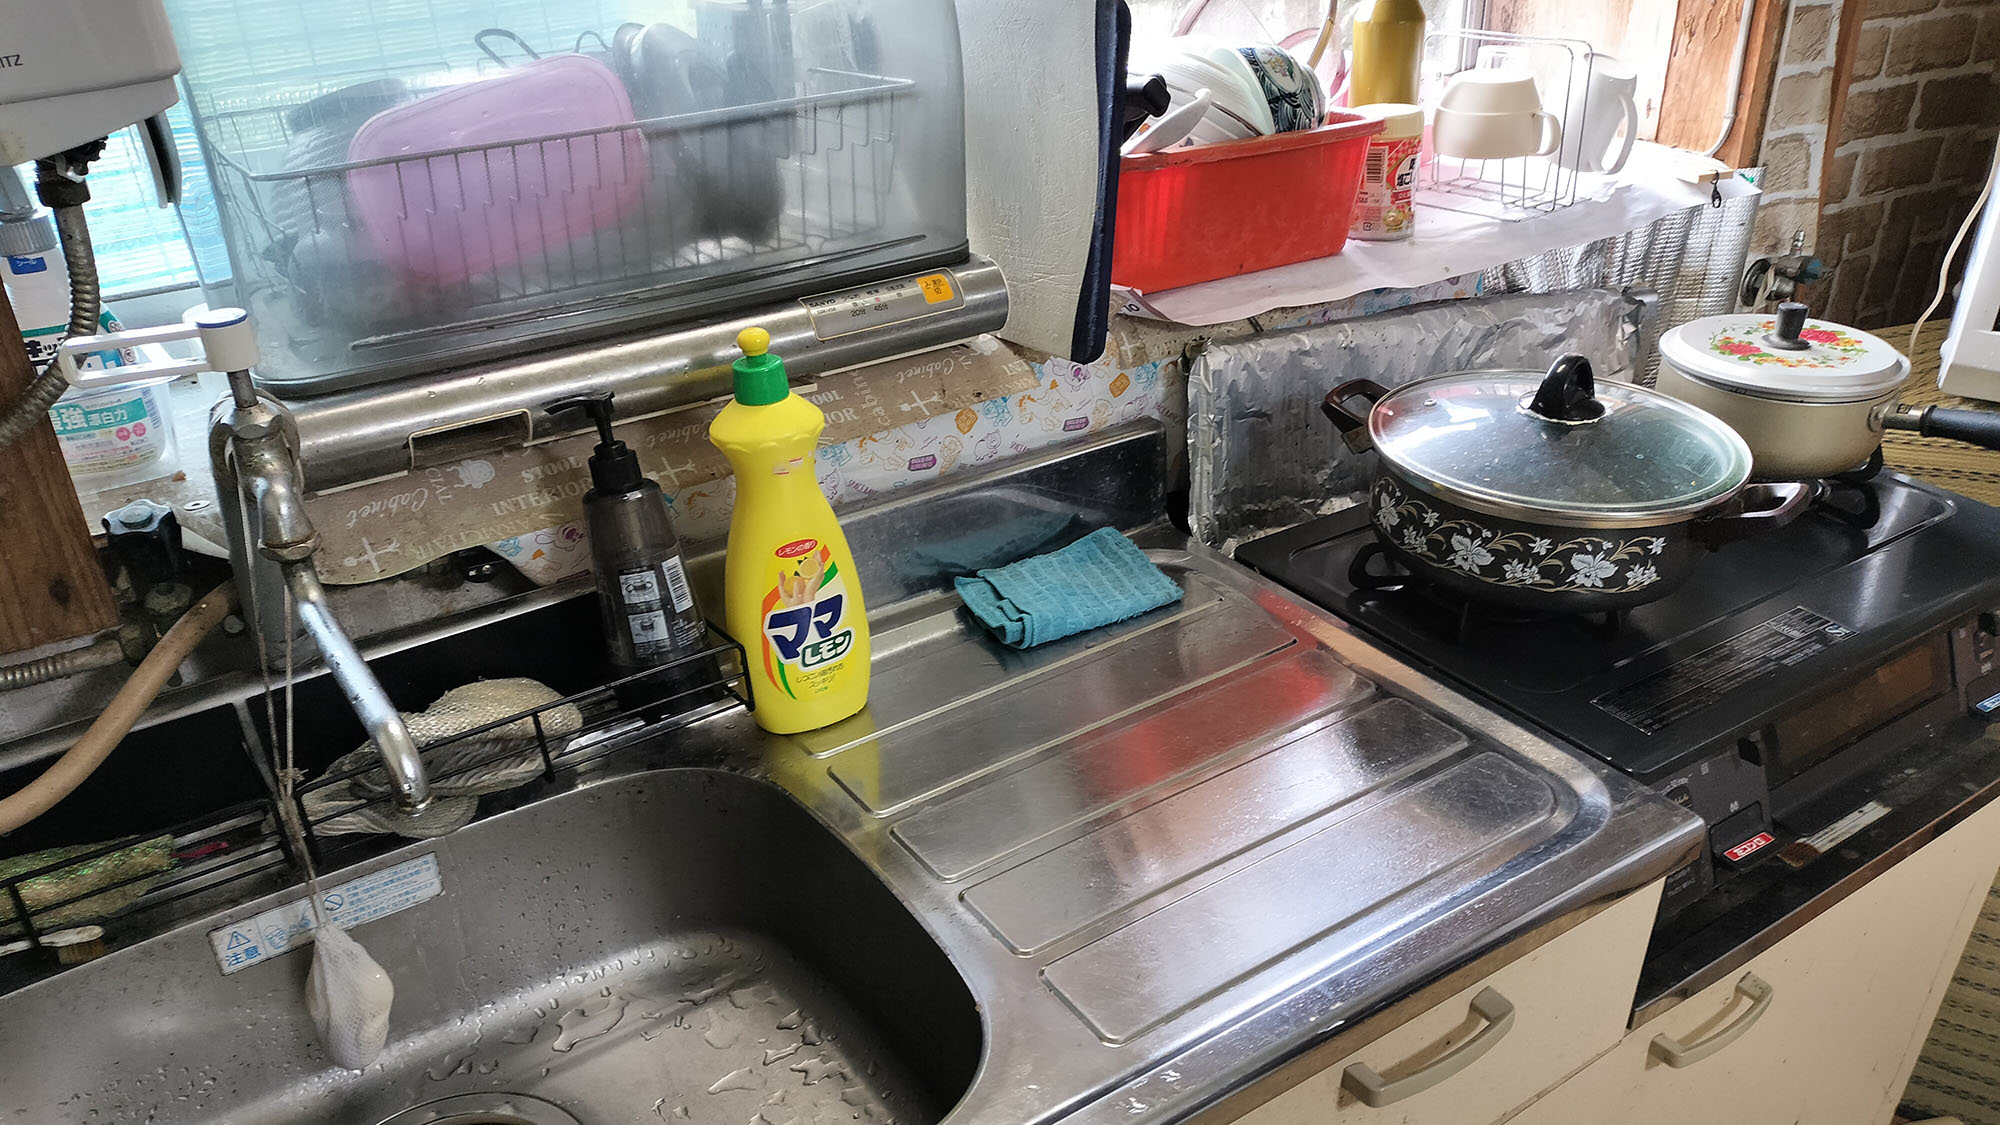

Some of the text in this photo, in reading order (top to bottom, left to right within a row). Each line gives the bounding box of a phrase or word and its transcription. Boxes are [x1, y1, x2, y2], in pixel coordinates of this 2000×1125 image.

[0, 54, 23, 69] ITZ
[778, 541, 818, 556] レモンの香り
[768, 594, 843, 660] ママ
[804, 635, 850, 665] レモン
[225, 945, 262, 967] 注意
